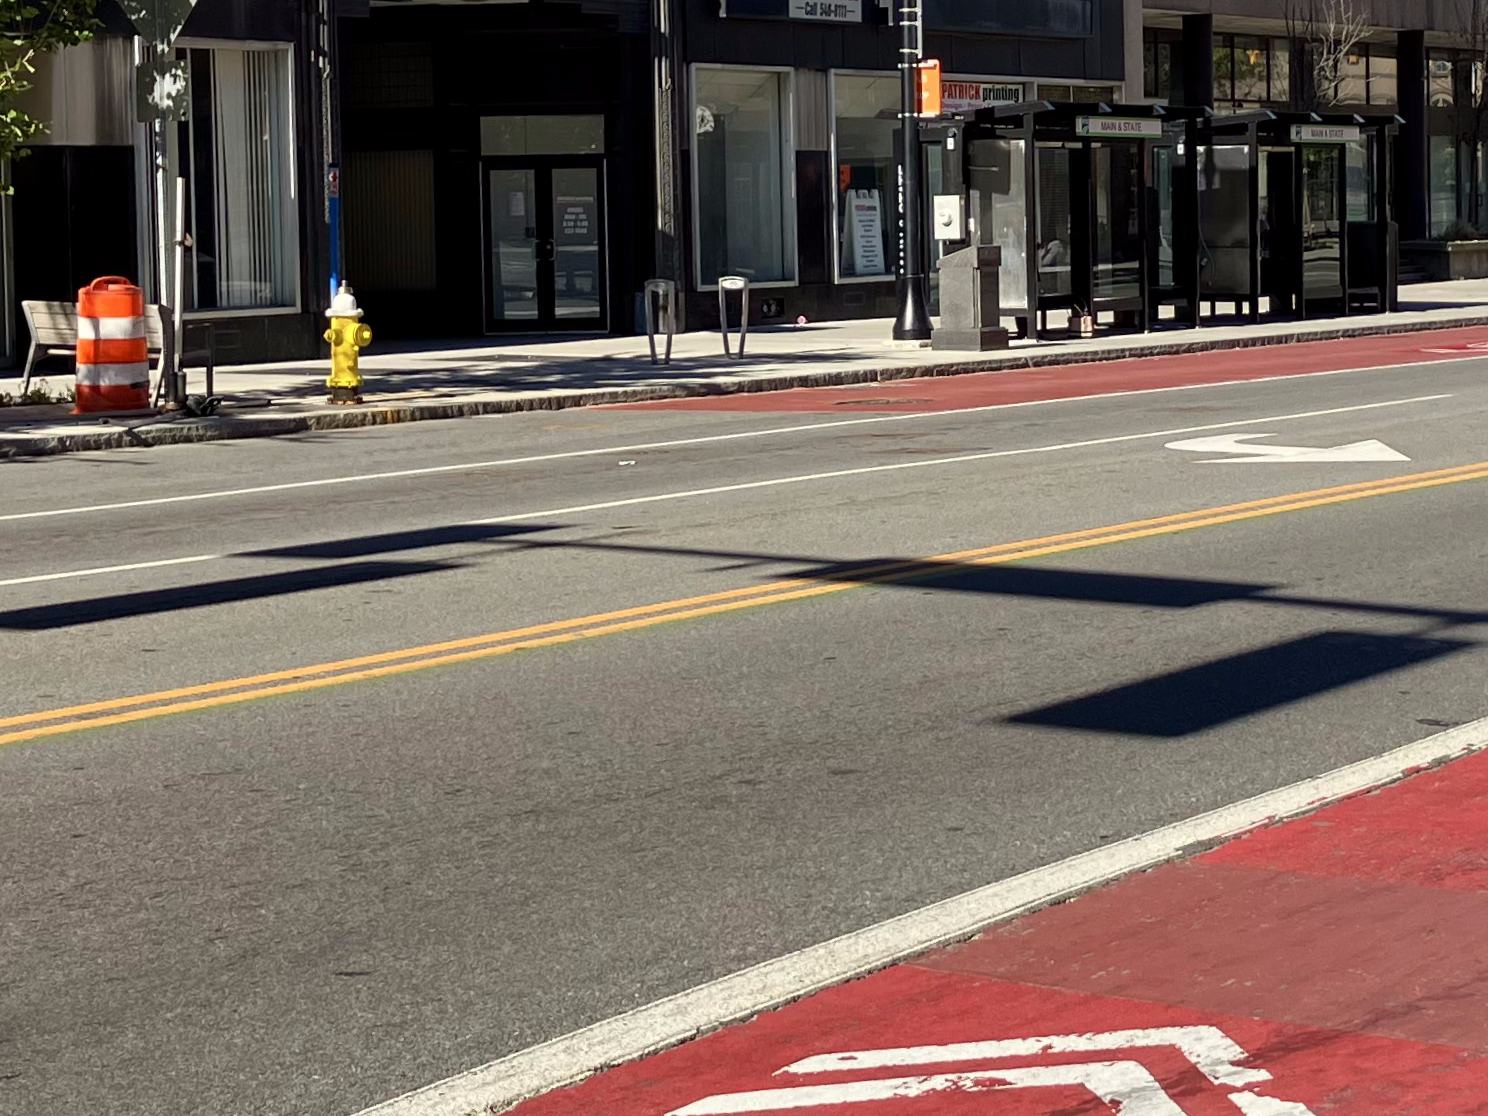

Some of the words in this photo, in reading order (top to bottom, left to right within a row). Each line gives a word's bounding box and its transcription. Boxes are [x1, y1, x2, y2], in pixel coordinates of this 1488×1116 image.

[982, 85, 1020, 104] printing
[1100, 121, 1117, 131] MAIN
[1123, 122, 1142, 133] STATE
